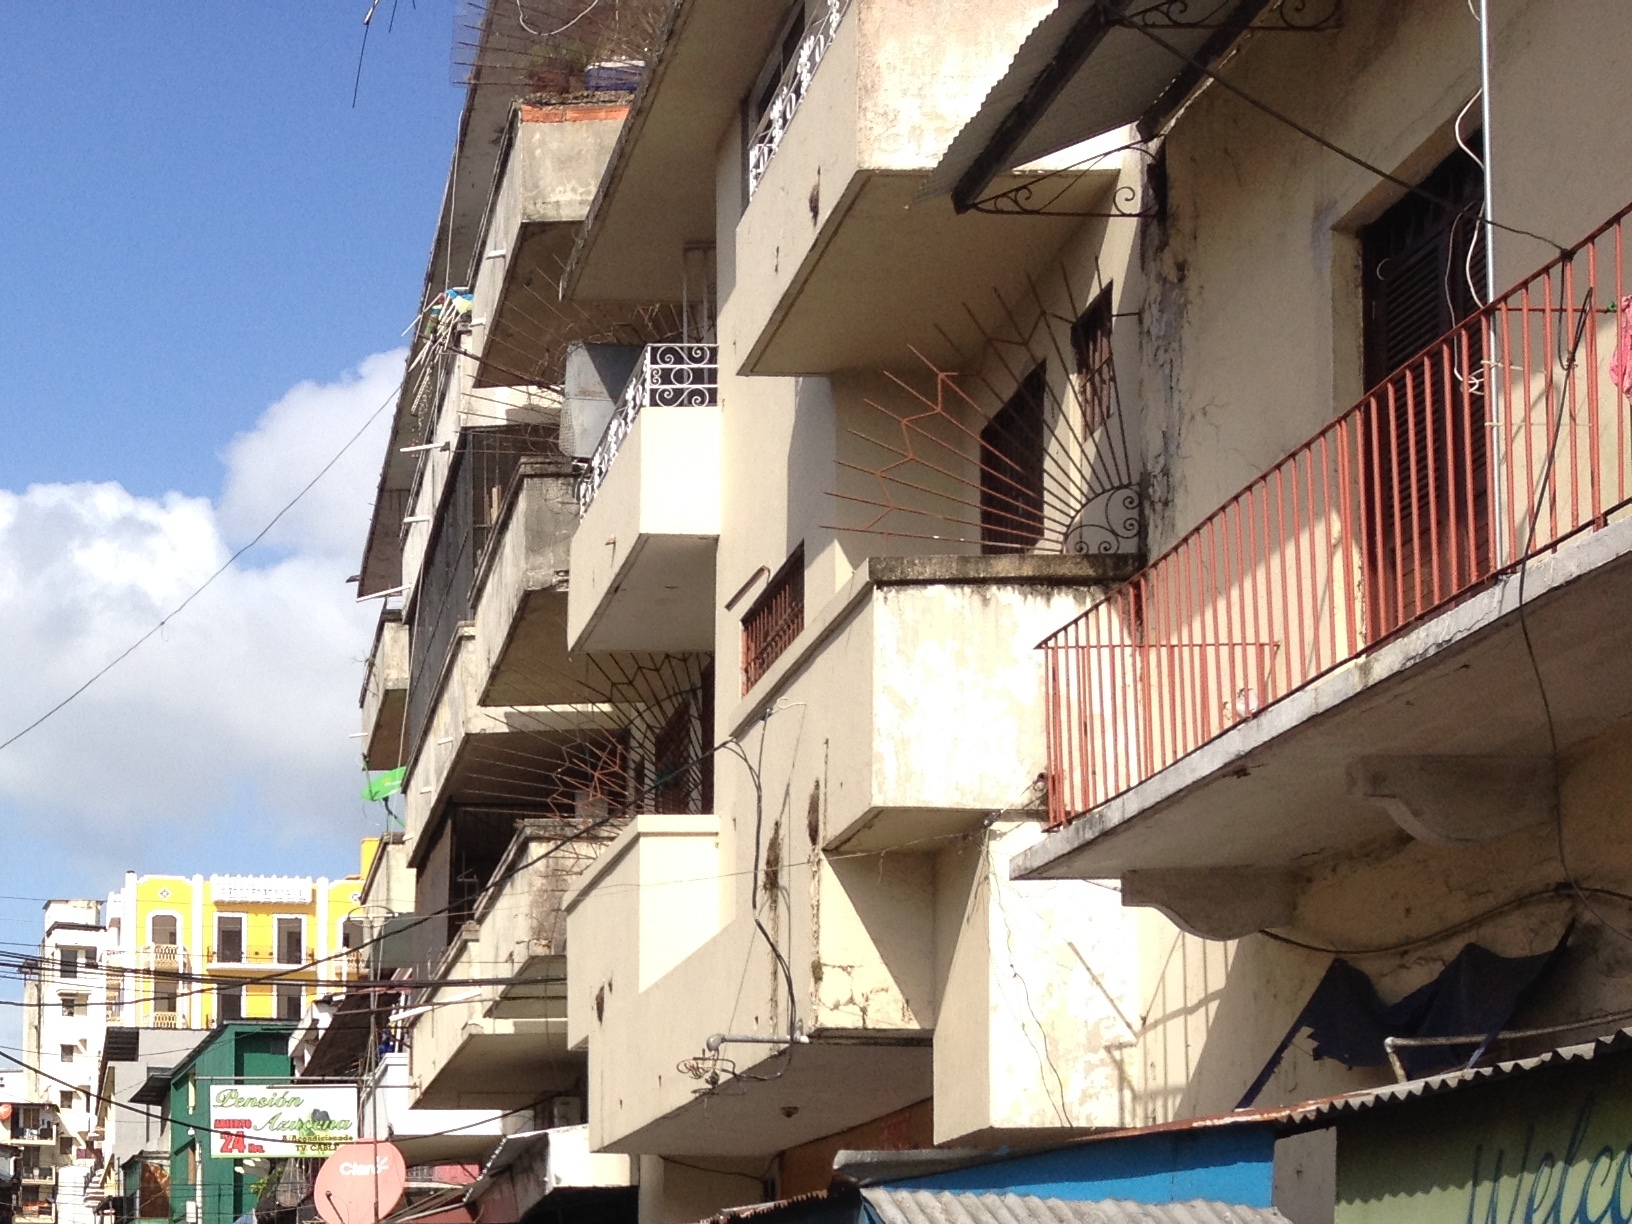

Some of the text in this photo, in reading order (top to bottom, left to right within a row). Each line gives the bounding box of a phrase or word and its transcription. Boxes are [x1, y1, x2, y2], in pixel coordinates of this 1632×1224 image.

[213, 1088, 304, 1108] Pensión
[253, 1112, 353, 1131] Azucena
[220, 1131, 246, 1153] 24
[339, 1161, 383, 1176] Claro
